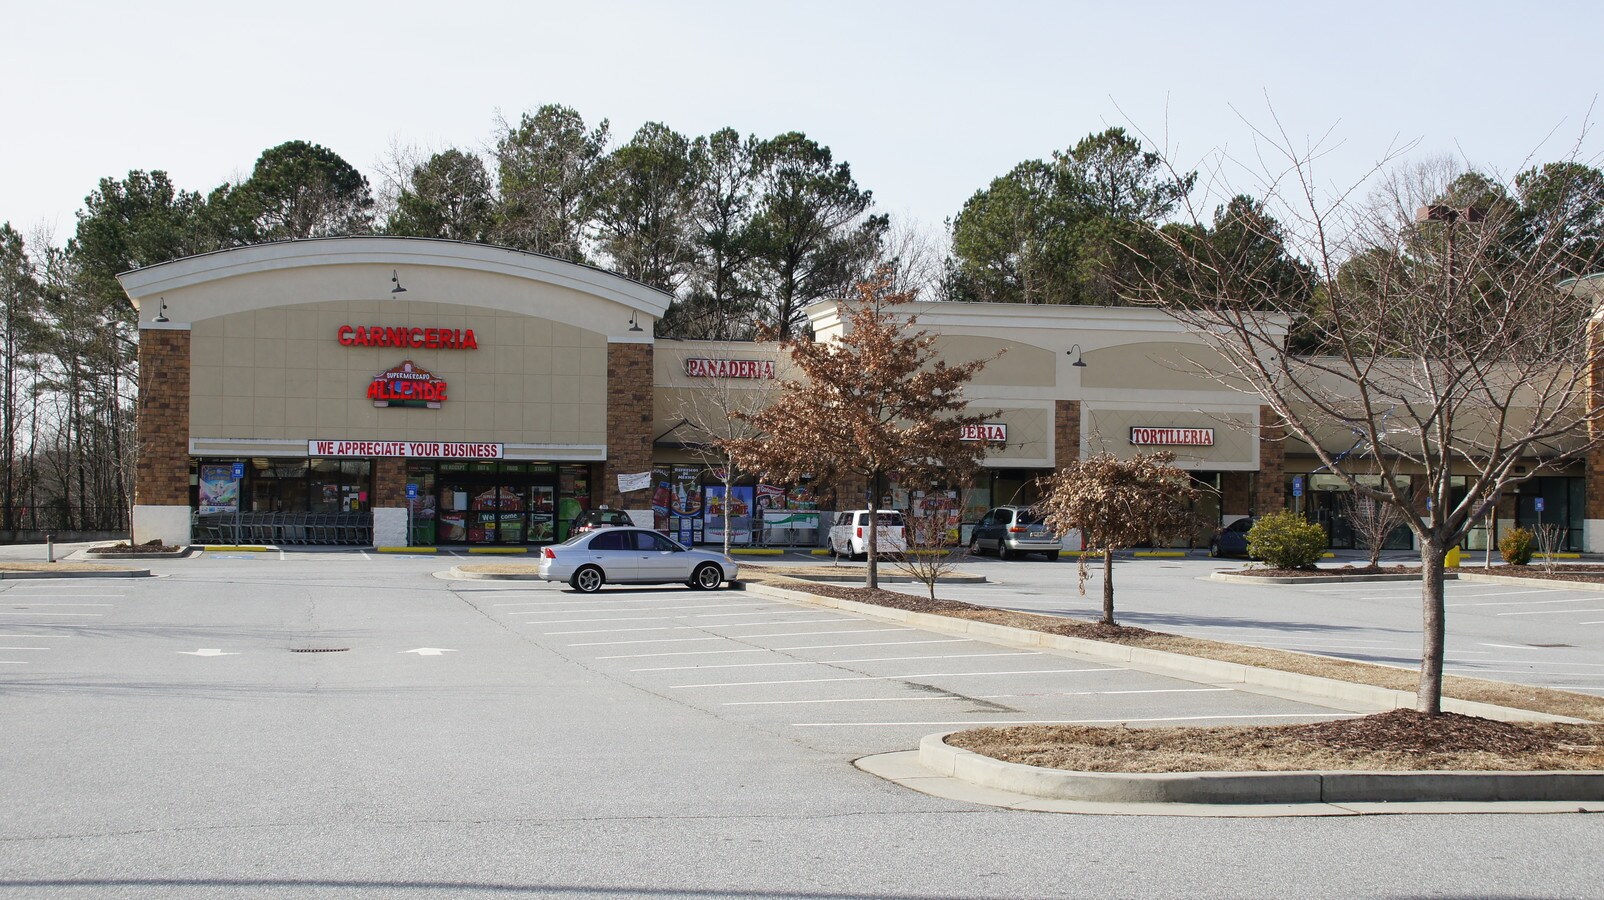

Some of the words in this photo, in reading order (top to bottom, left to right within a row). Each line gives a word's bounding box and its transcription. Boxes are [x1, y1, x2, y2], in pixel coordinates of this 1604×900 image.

[337, 325, 477, 350] CARNICERIA
[386, 372, 430, 381] SUPERMERCADO
[689, 360, 773, 377] PANADERIA
[367, 381, 448, 401] ALLENDE
[1133, 429, 1212, 444] TORTILLERIA
[316, 441, 334, 455] WE
[337, 442, 406, 456] APPRECIATE
[409, 442, 440, 457] YOUR
[443, 443, 498, 457] BUSINESS
